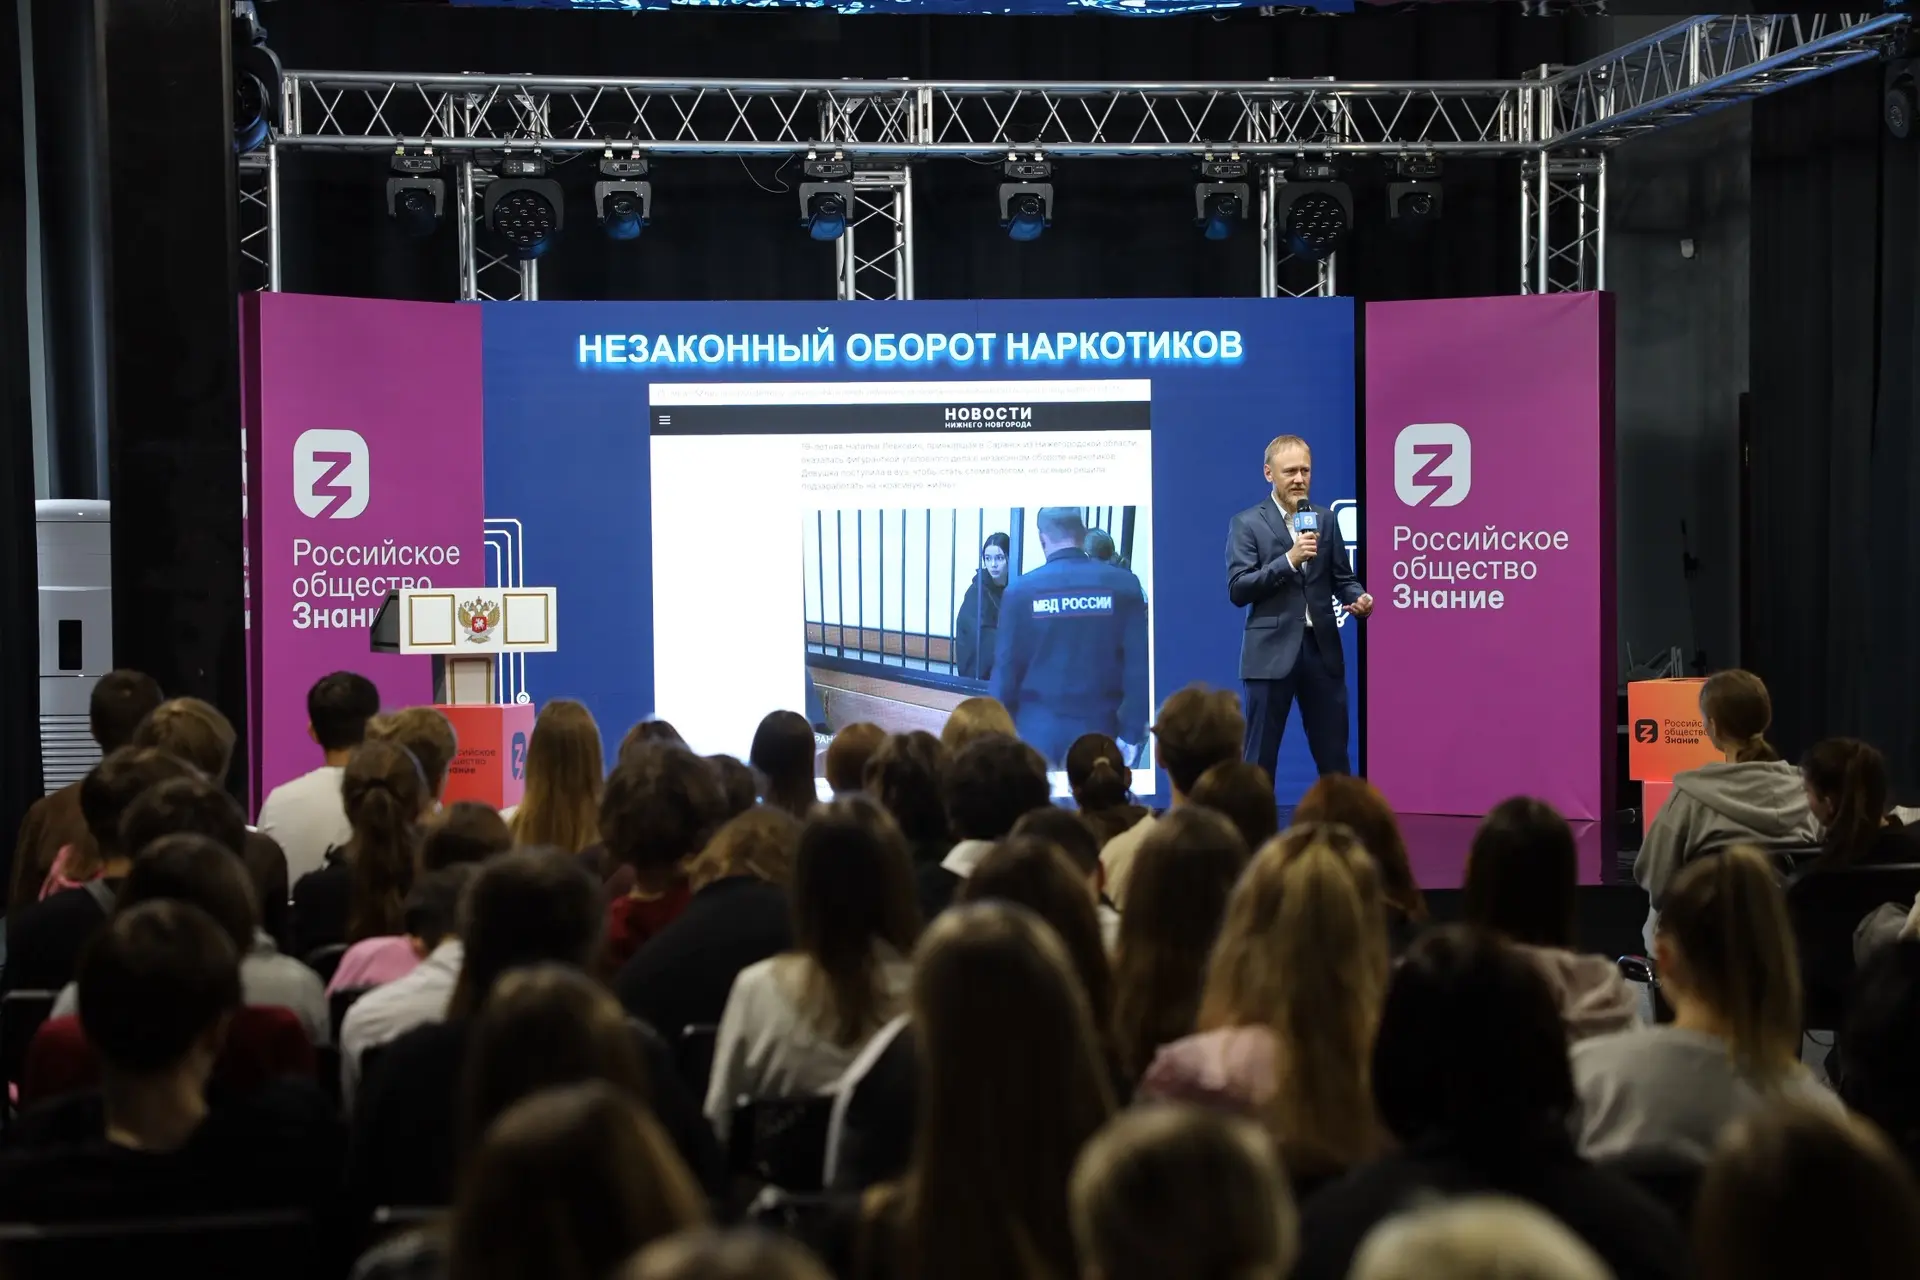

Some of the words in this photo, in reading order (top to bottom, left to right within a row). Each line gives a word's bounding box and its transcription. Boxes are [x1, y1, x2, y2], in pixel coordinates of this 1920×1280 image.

[578, 326, 835, 363] НЕЗАКОННЫЙ
[846, 332, 997, 362] ОБОРОТ
[1006, 329, 1244, 361] НАРКОТИКОВ
[944, 406, 1032, 421] НОВОСТИ
[944, 421, 983, 430] НИЖНЕГО
[985, 420, 1032, 430] НОВГОРОДА
[1393, 525, 1569, 551] Российское
[293, 538, 460, 566] Российское
[1393, 555, 1538, 583] общество
[1033, 597, 1060, 613] МВД
[1061, 596, 1112, 610] РОССИИ
[1393, 583, 1505, 610] Знание
[1664, 719, 1703, 728] Российс
[1664, 736, 1700, 745] Знание
[458, 748, 496, 757] сийское
